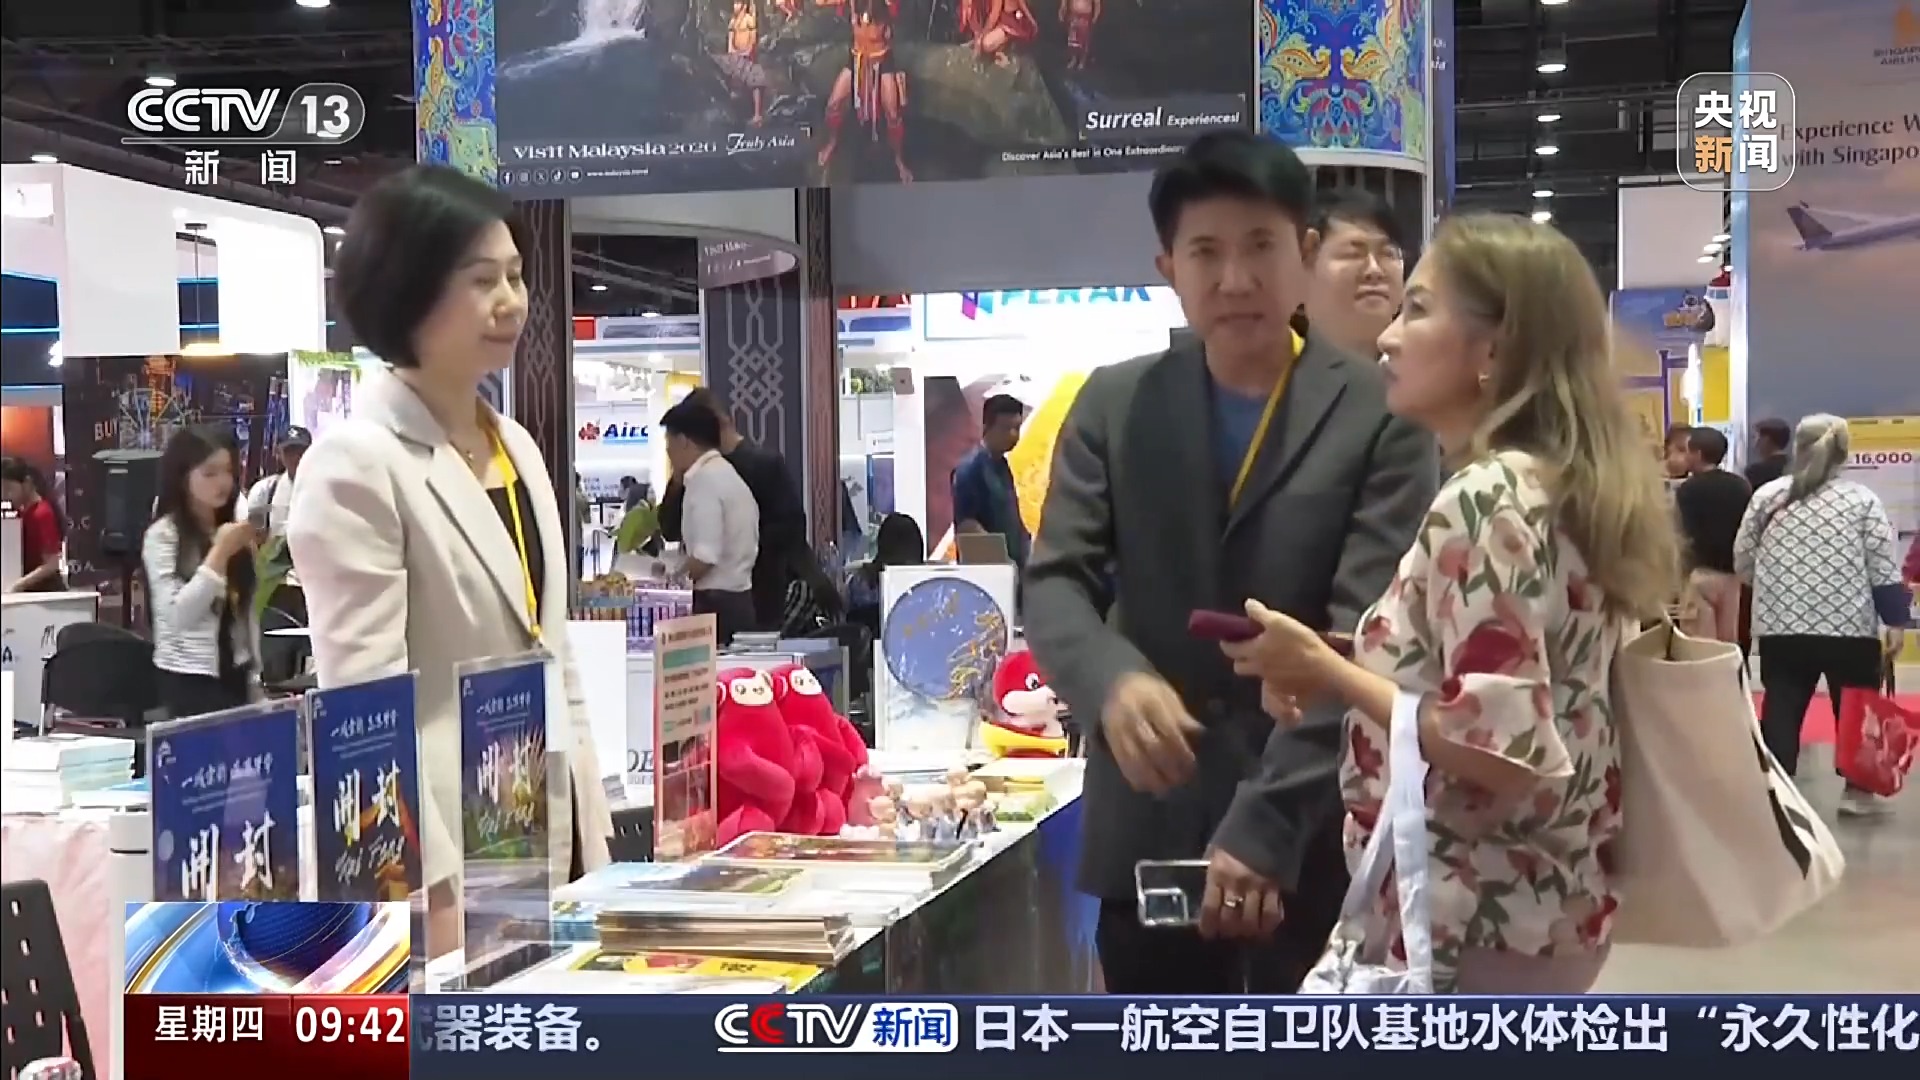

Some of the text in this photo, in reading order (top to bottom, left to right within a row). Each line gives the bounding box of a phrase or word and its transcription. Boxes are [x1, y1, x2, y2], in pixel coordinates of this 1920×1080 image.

[1086, 106, 1240, 130] Surreal Experiences!
[1781, 120, 1894, 144] Experience
[513, 144, 563, 159] Visit
[568, 141, 665, 160] Malaysia
[767, 134, 795, 148] Asia
[1002, 152, 1040, 162] Discover
[1043, 149, 1069, 160] Asia's
[1782, 147, 1825, 167] with
